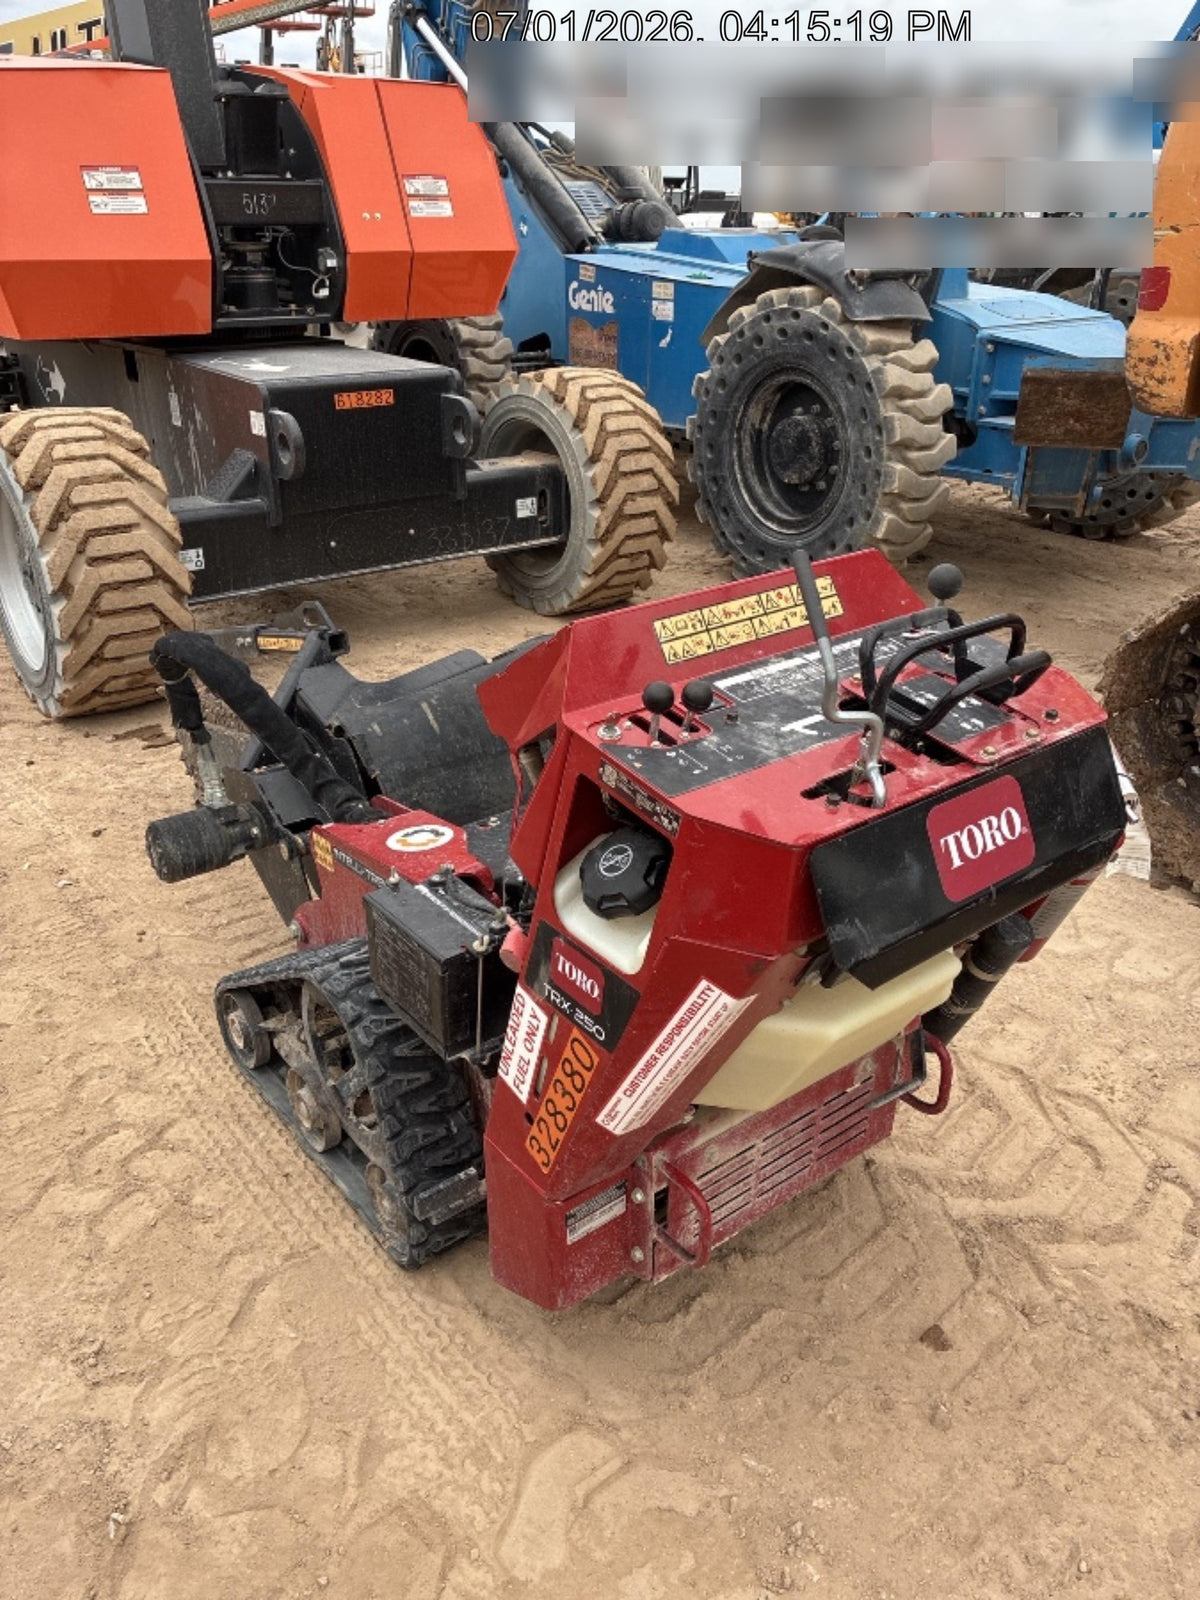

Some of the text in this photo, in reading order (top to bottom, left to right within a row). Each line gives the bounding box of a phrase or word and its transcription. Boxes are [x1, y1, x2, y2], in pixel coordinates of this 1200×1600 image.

[568, 280, 616, 314] Genie
[940, 806, 1022, 870] TORO
[556, 952, 600, 998] TORO
[500, 992, 526, 1077] UNLEADED
[513, 1007, 542, 1096] FUEL ONLY
[623, 1054, 660, 1099] CUSTOMER
[655, 983, 716, 1057] RESPONSIBILITY
[529, 1036, 595, 1168] 328380
